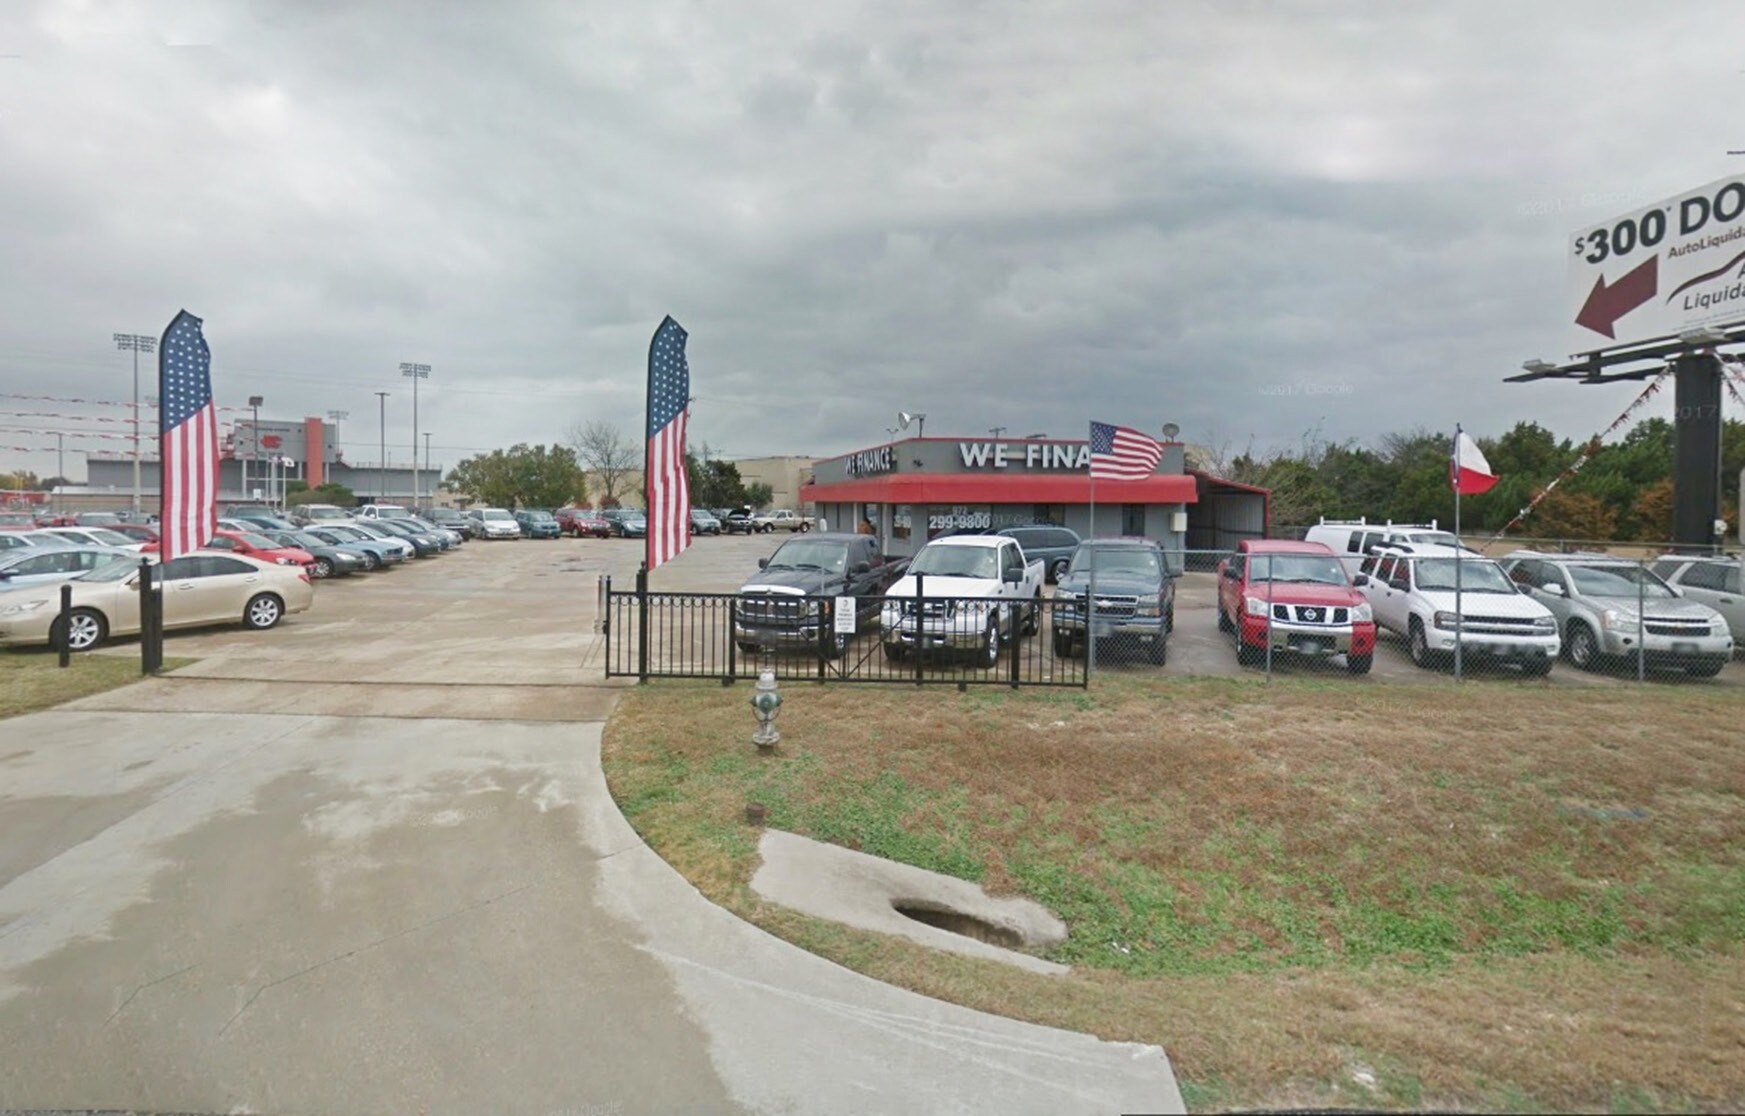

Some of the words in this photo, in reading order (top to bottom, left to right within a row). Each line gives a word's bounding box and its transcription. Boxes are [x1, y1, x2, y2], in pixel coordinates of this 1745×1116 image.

[1680, 182, 1745, 236] DO
[960, 442, 1008, 467] WE
[1026, 444, 1090, 468] FINA
[929, 515, 990, 529] 299-9800
